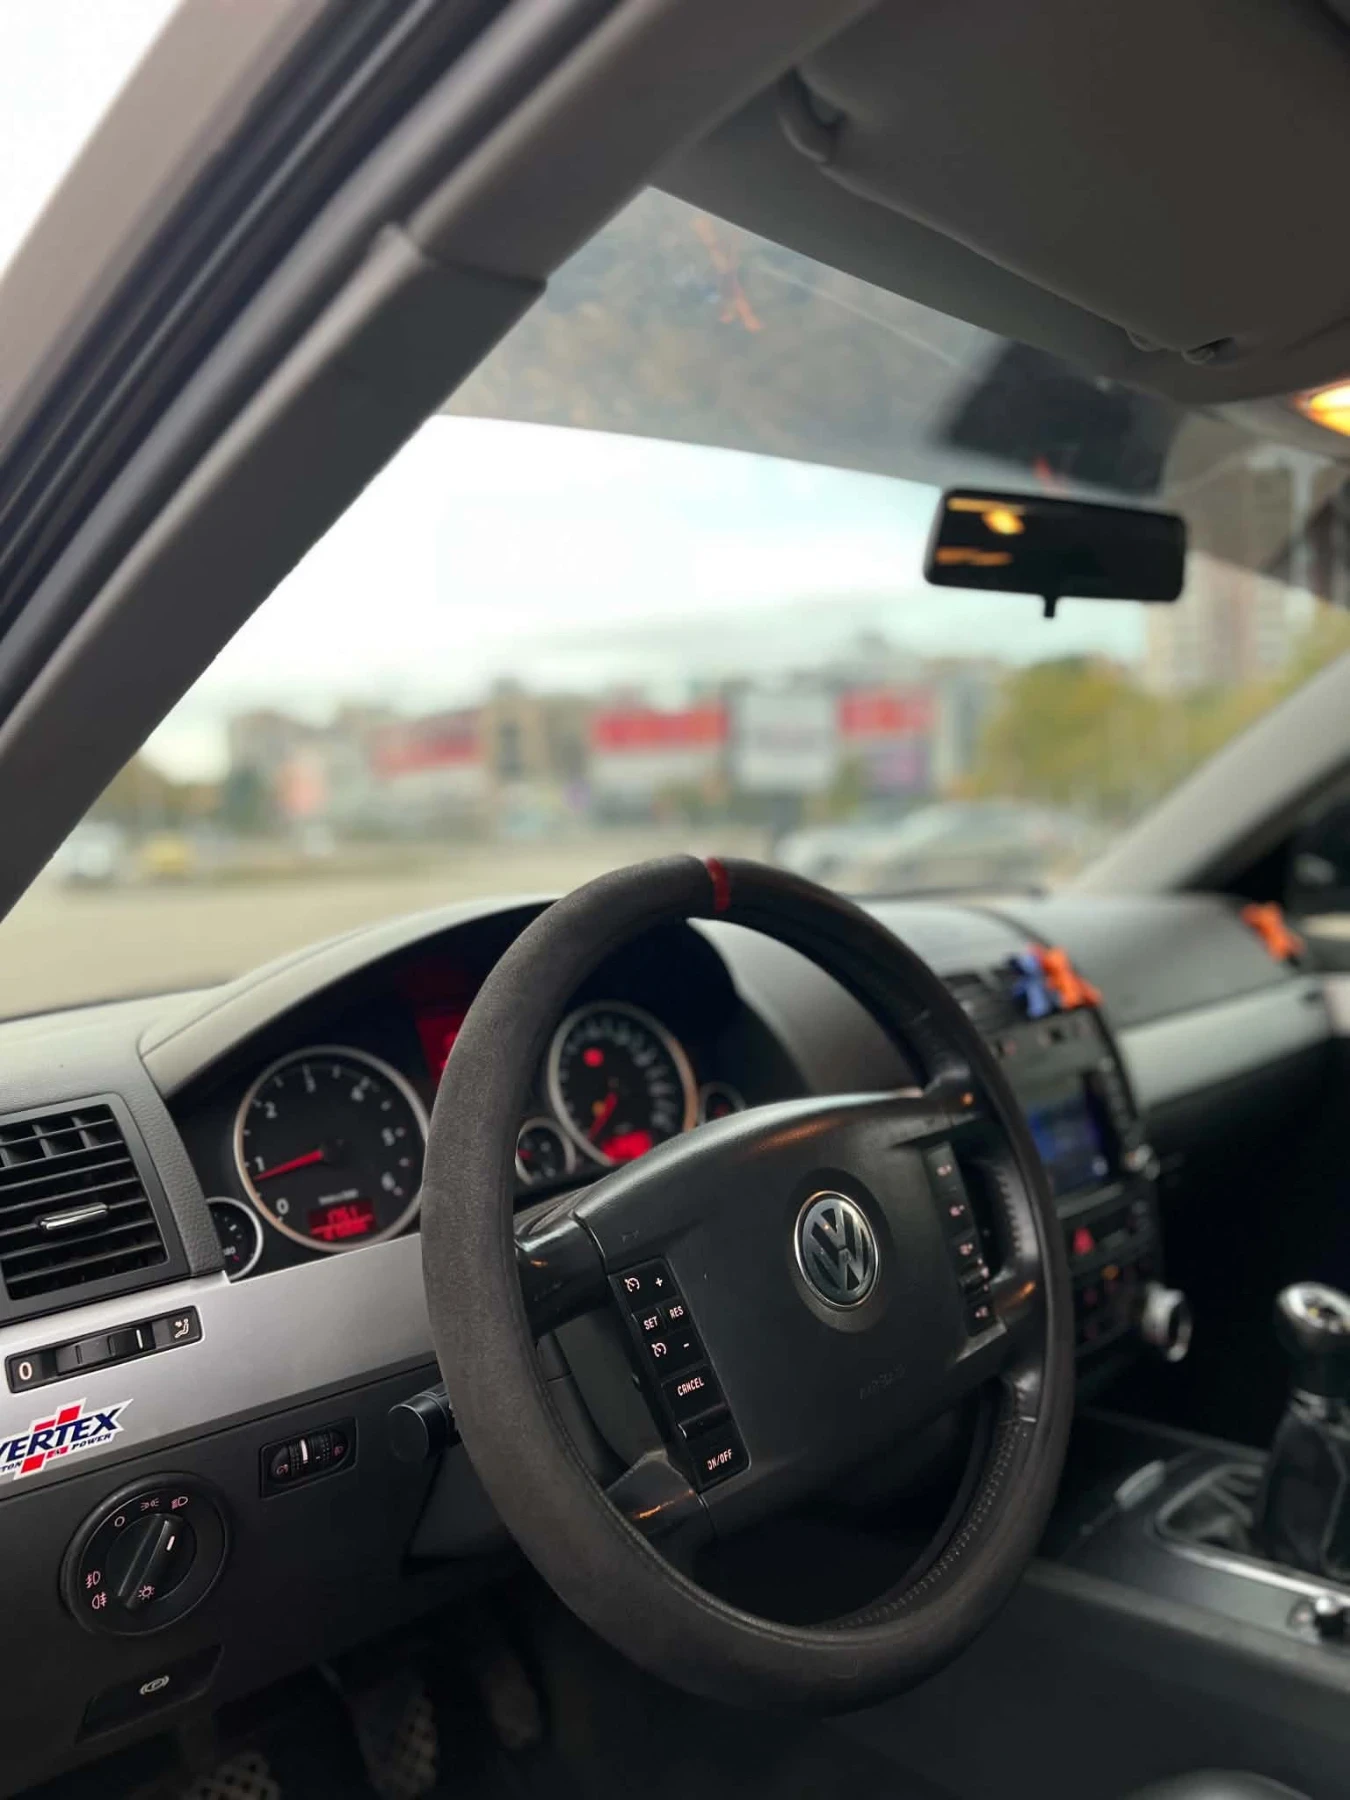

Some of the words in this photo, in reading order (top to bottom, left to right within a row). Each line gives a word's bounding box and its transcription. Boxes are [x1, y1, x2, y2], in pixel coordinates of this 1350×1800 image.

[669, 1306, 684, 1319] RES
[643, 1316, 658, 1330] SET
[677, 1376, 705, 1397] CANCEL
[71, 1433, 112, 1451] POWER
[707, 1449, 732, 1470] ON/OFF
